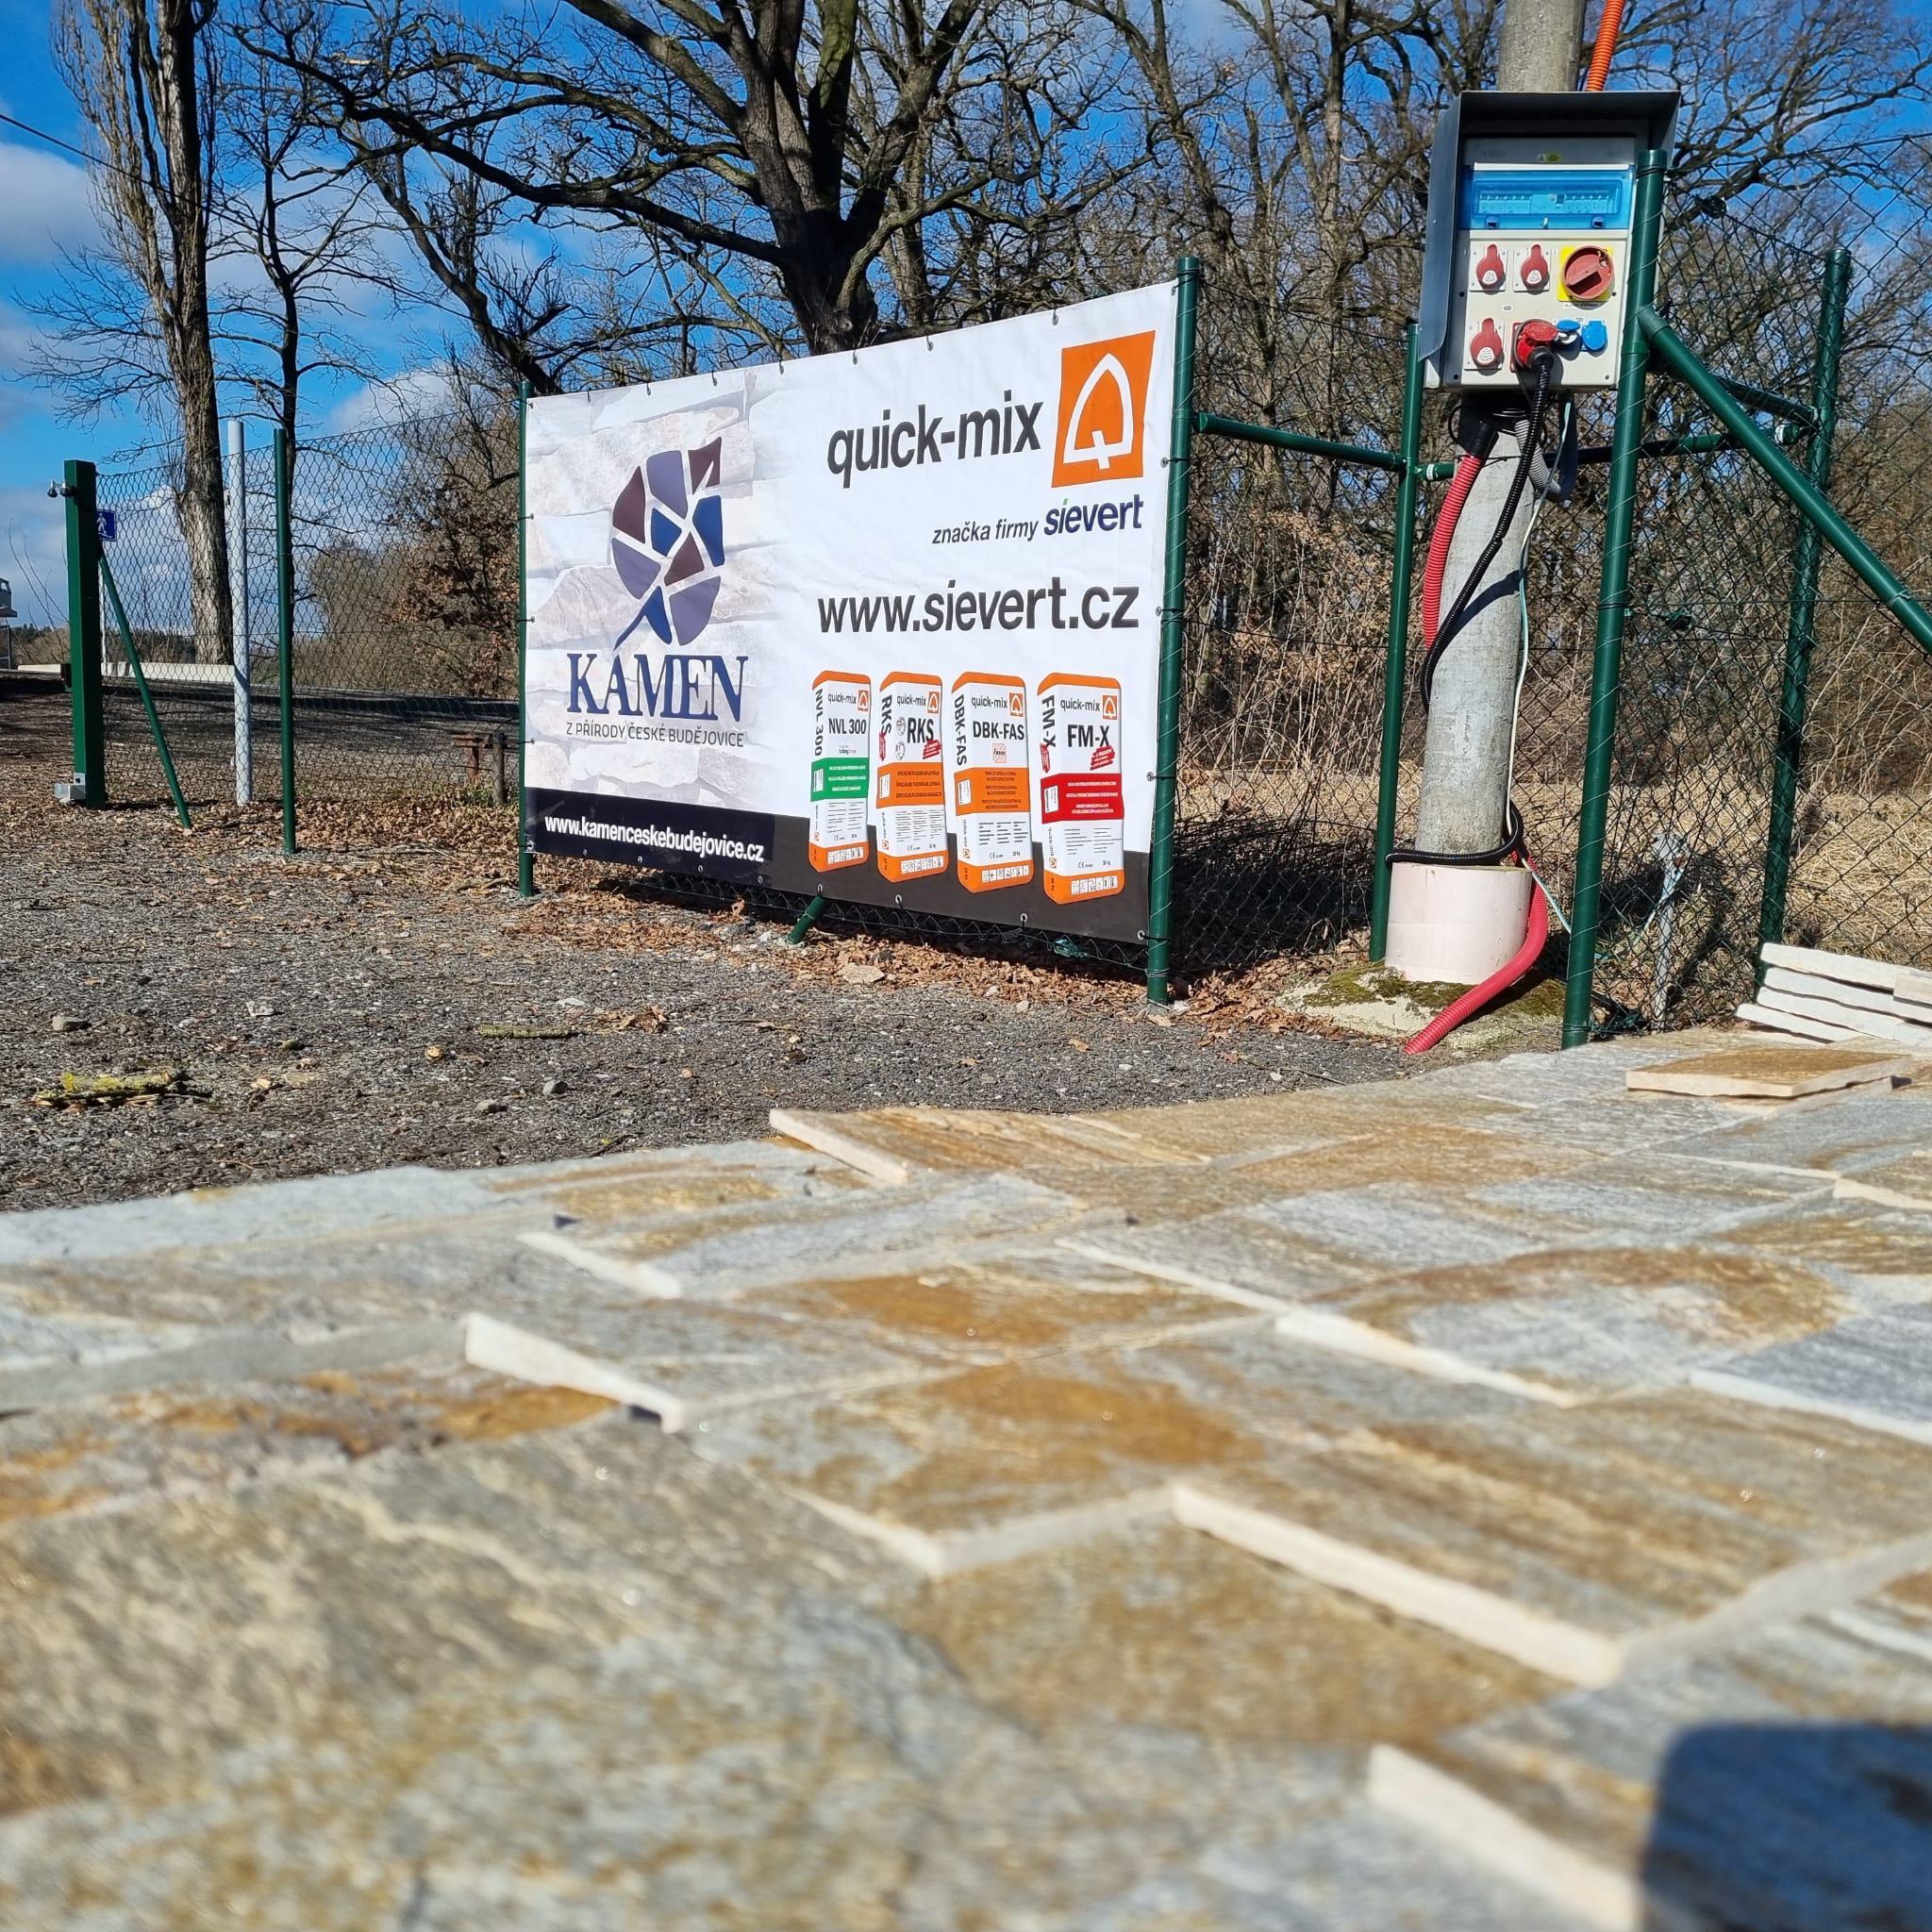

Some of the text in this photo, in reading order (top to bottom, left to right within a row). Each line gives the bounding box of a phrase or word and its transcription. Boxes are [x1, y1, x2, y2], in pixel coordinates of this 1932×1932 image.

[826, 389, 1044, 489] quick-mix
[931, 493, 1144, 544] značka firmy sievert
[817, 575, 1140, 633] www.sievert.cz
[566, 652, 749, 723] KAMEN
[827, 691, 857, 705] quick-mix
[896, 694, 927, 708] quick-mix
[971, 694, 1008, 708] quick-mix
[1059, 697, 1101, 712] quick-mix
[566, 719, 745, 748] Z PŘÍRODY ČESKÉ BUDĚJOVICE
[828, 717, 867, 735] NVL 300
[907, 717, 934, 743] RKS
[954, 693, 968, 766] DBK-FAS
[973, 720, 1025, 741] DBK-FAS
[1041, 694, 1057, 748] FM-X
[1067, 724, 1110, 748] FM-X
[544, 815, 765, 863] www.kamenceskebudejovice.cz
